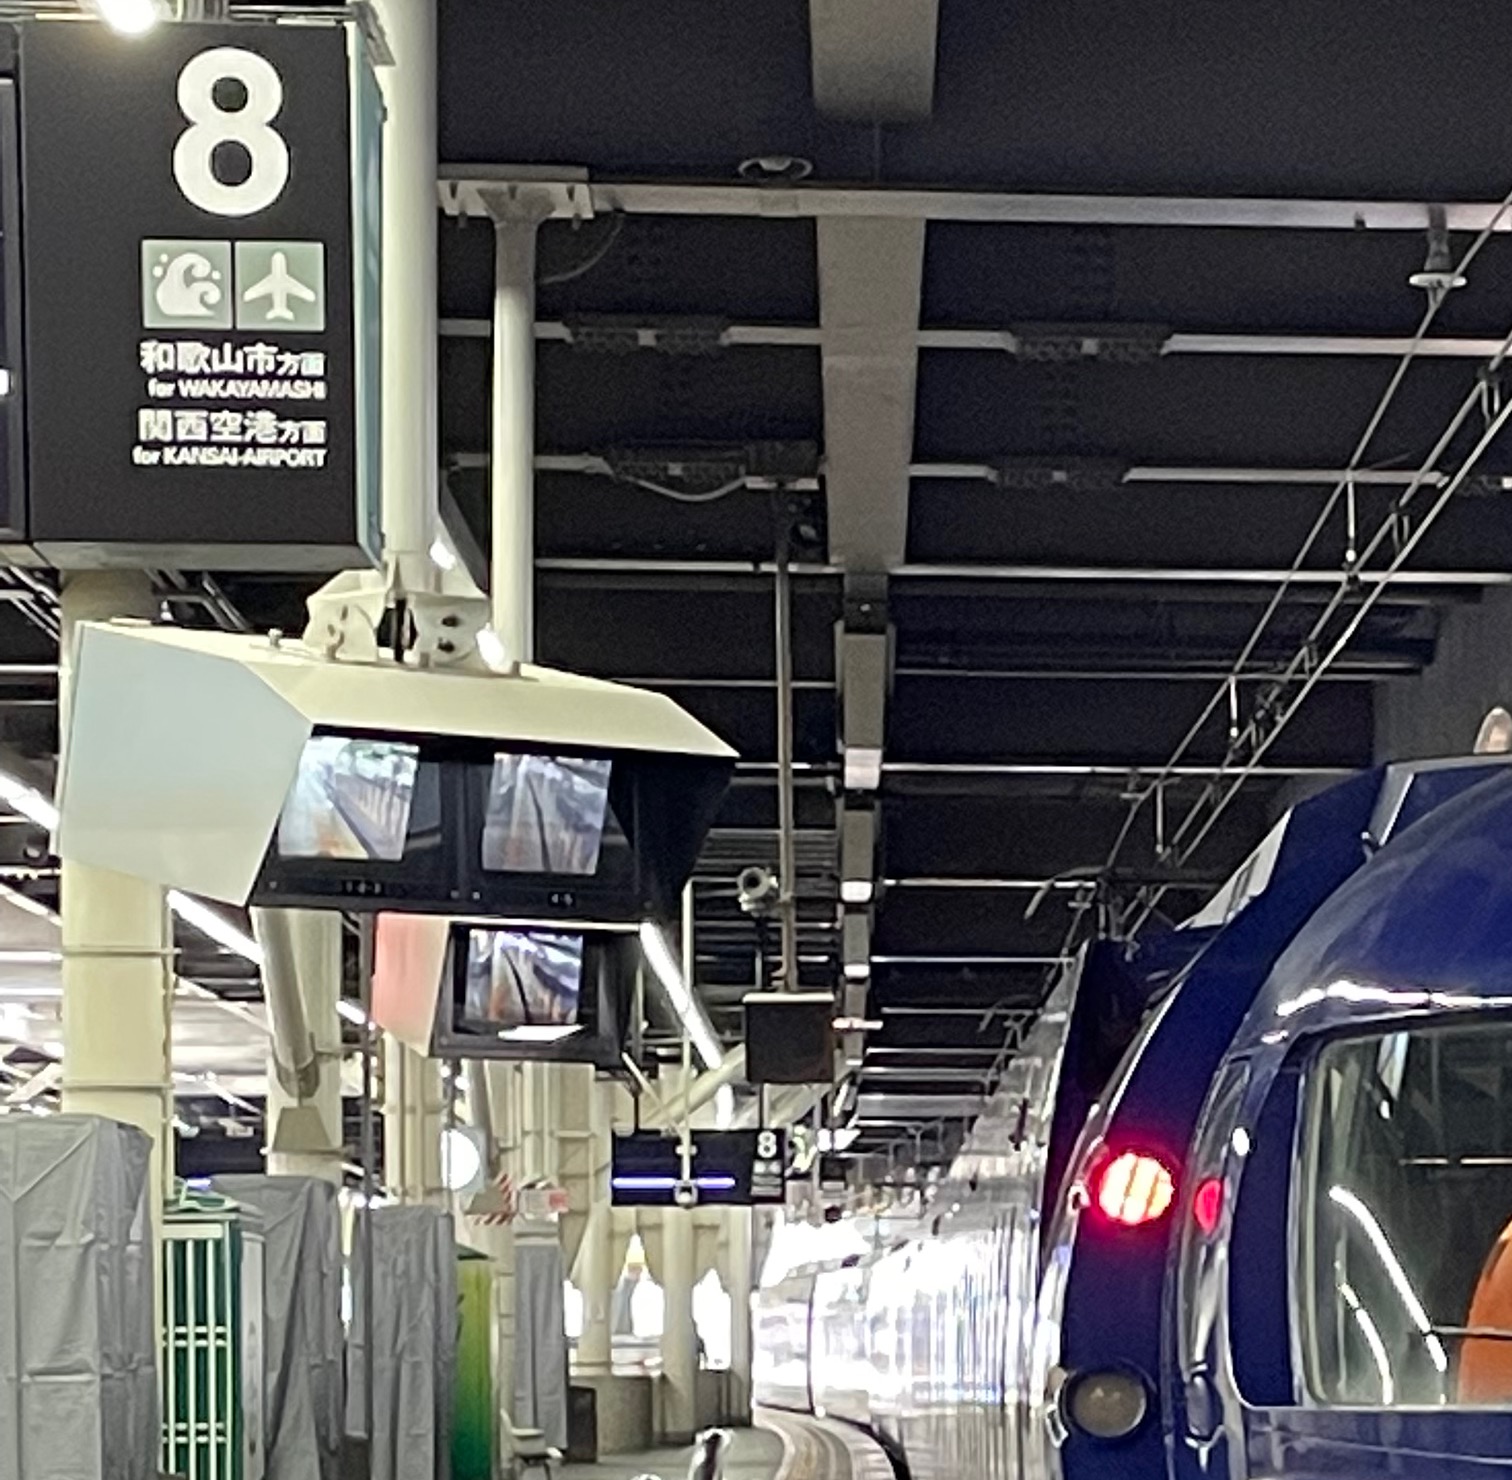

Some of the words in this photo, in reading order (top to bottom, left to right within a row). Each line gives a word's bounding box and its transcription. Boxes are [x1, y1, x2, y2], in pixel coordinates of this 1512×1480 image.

[172, 47, 290, 217] 8
[139, 340, 326, 376] 和歌山市方面
[148, 378, 176, 397] for
[178, 379, 327, 399] WAKAYAMASHI
[138, 408, 327, 444] 関西空港方面
[132, 446, 161, 465] for
[757, 1130, 777, 1158] 8
